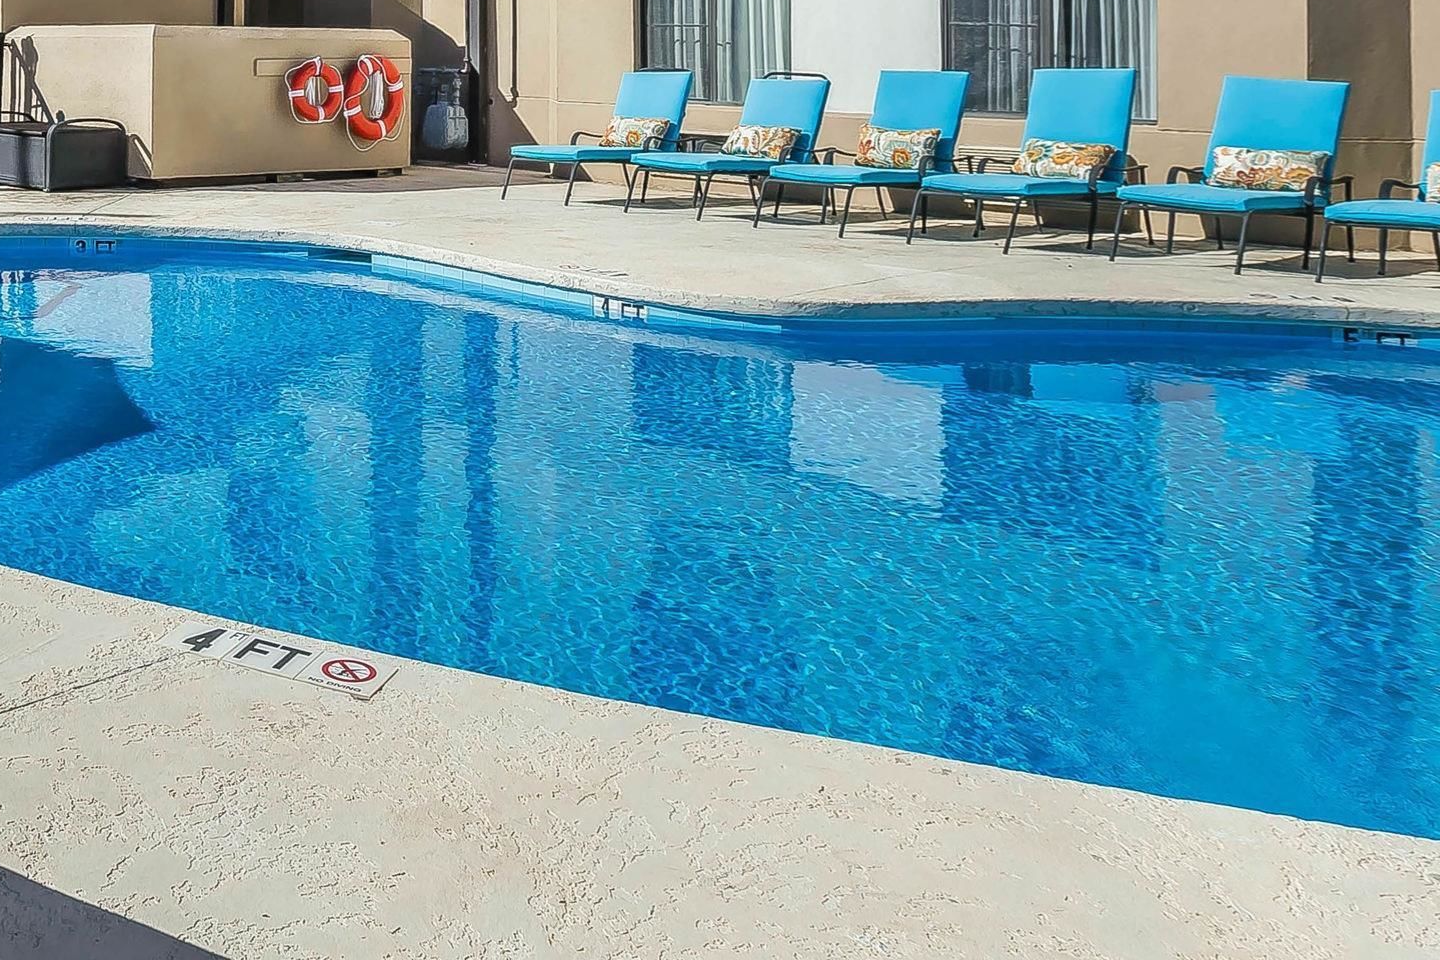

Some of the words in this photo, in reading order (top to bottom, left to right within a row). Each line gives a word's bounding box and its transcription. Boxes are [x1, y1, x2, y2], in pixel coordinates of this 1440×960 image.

[229, 632, 249, 641] FT
[182, 628, 228, 652] 4
[233, 638, 312, 670] FT
[326, 681, 362, 692] DIVING
